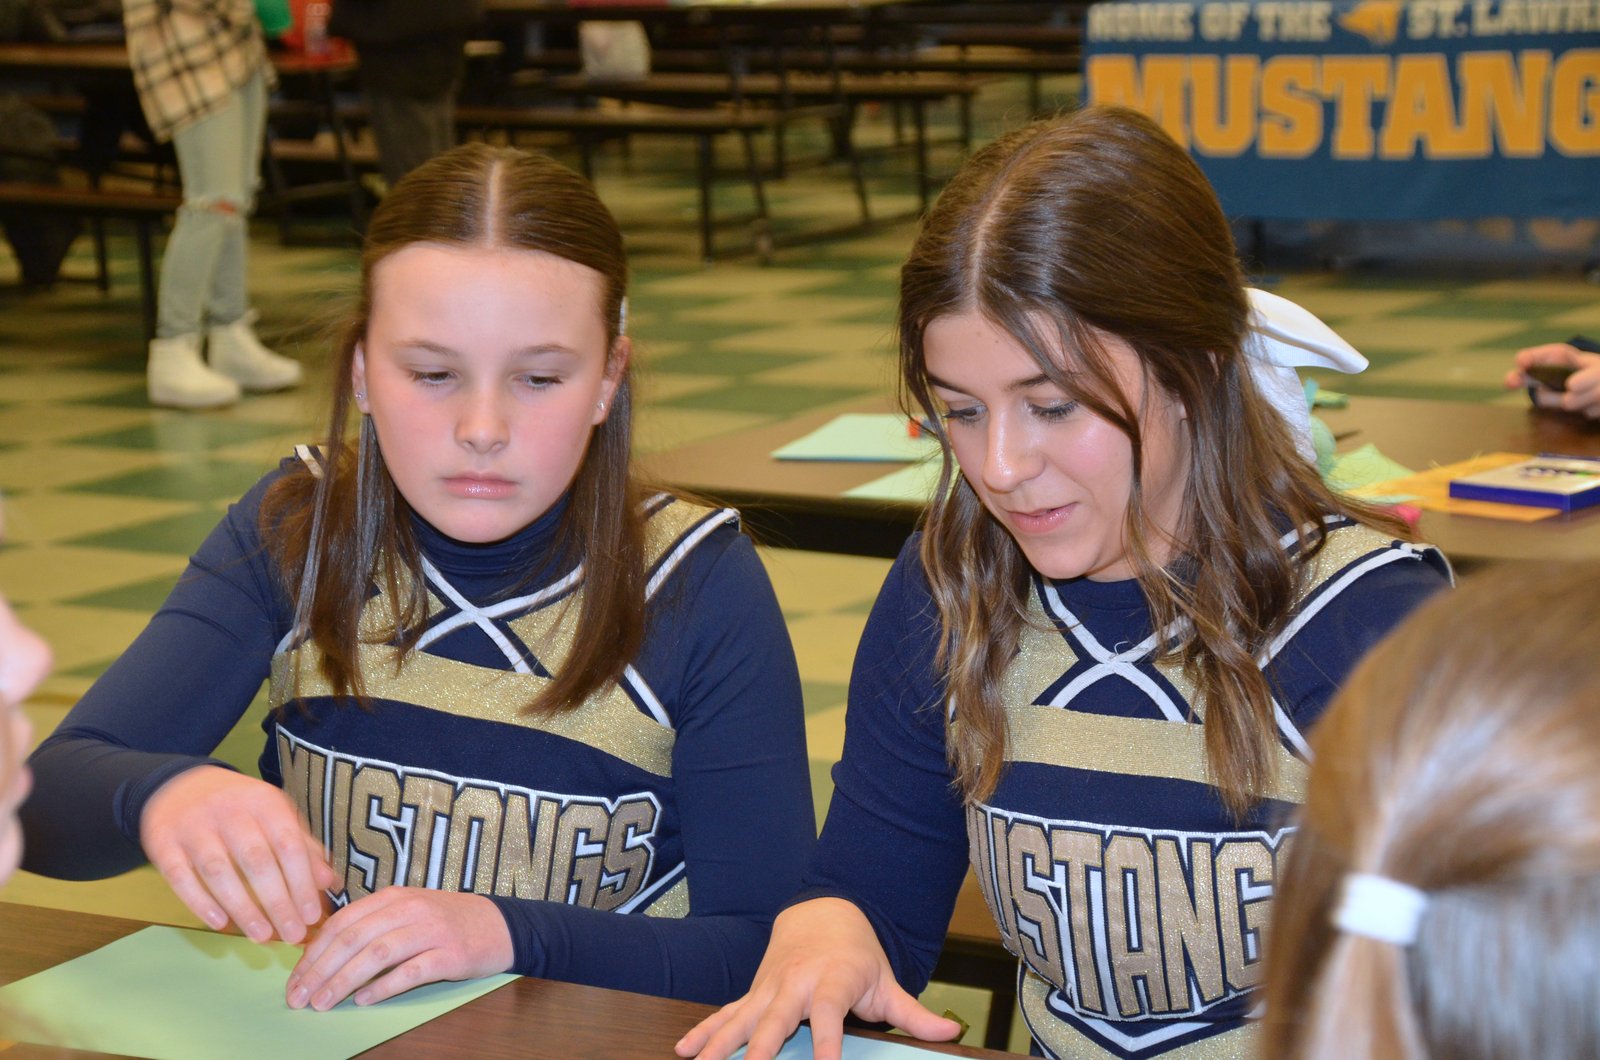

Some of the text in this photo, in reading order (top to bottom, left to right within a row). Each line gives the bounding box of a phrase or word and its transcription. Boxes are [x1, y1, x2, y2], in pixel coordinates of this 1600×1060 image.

[1086, 1, 1333, 41] HOME OF THE
[1404, 0, 1468, 39] ST.
